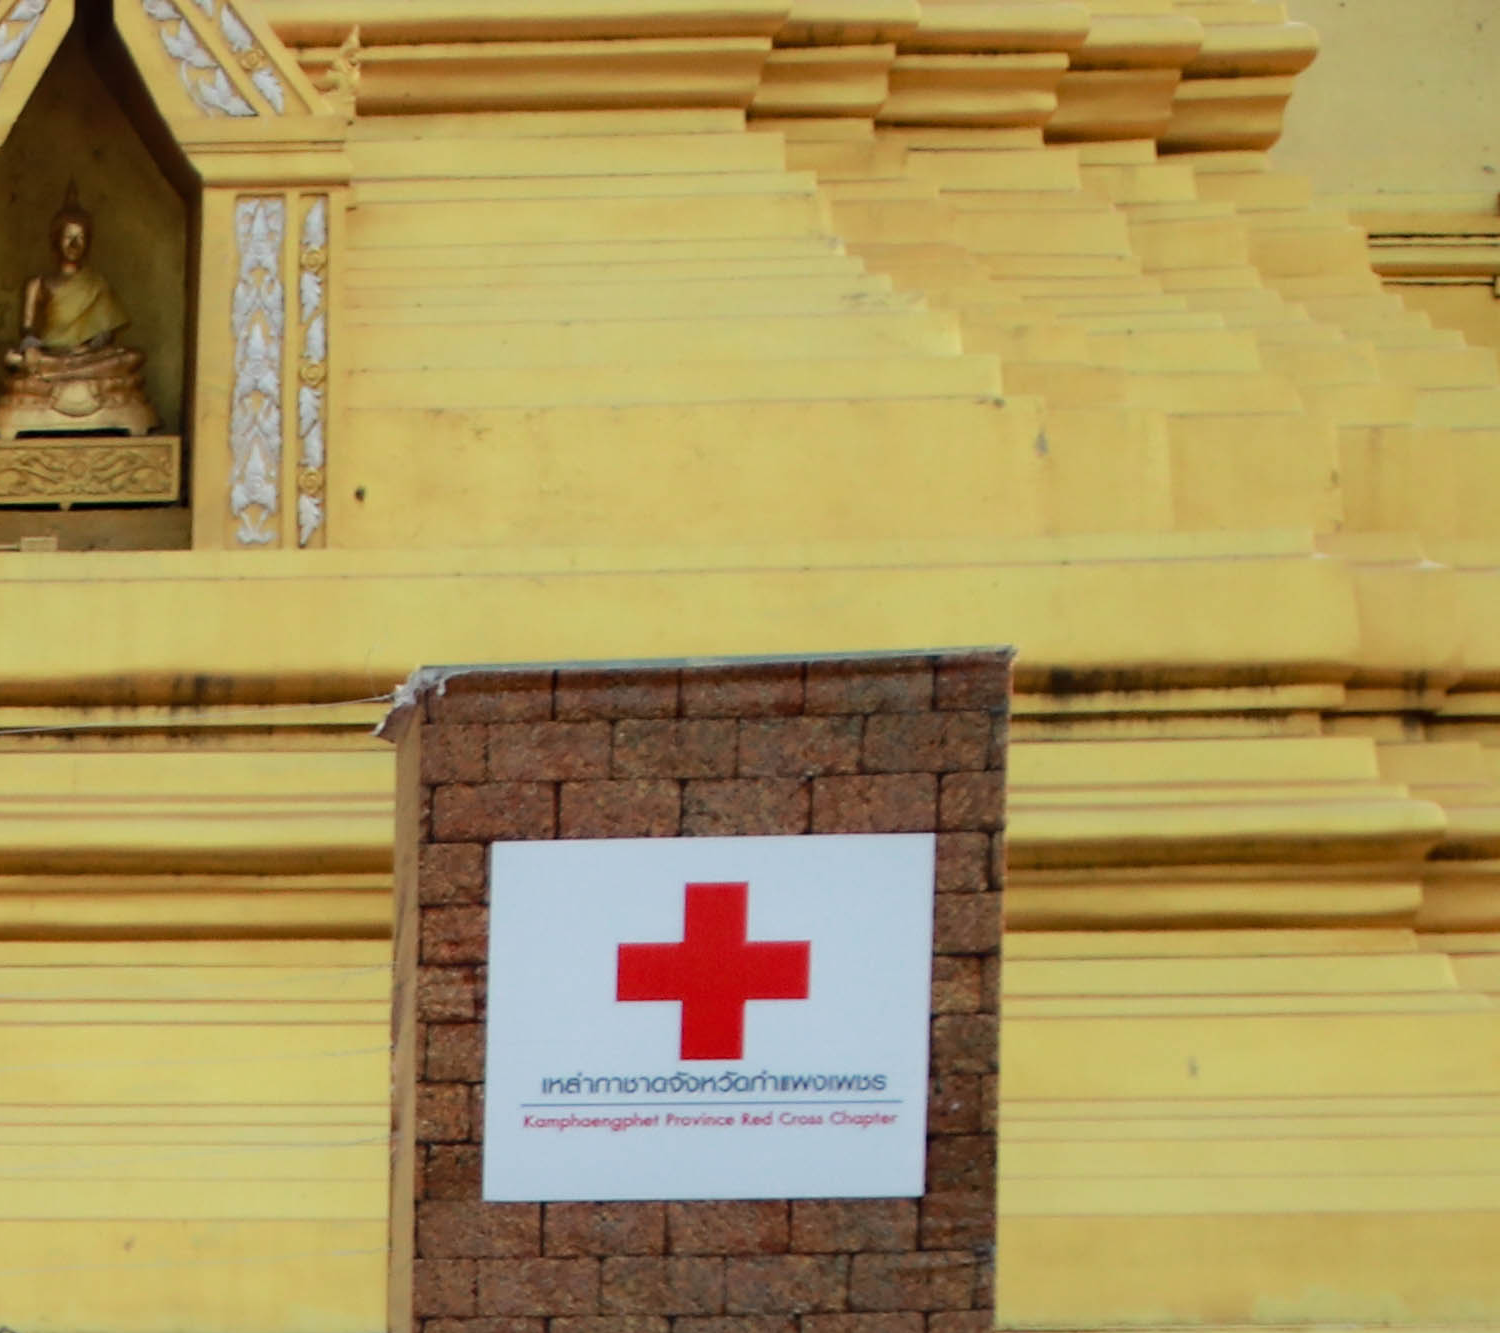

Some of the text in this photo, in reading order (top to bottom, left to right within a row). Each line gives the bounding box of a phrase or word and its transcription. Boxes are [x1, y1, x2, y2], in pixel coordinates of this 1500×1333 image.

[541, 1069, 887, 1096] เหล่ากาชาดจังหวัดกำแพงเพชร
[522, 1110, 898, 1135] Kamphaengphet Province Red Cross Chapter
